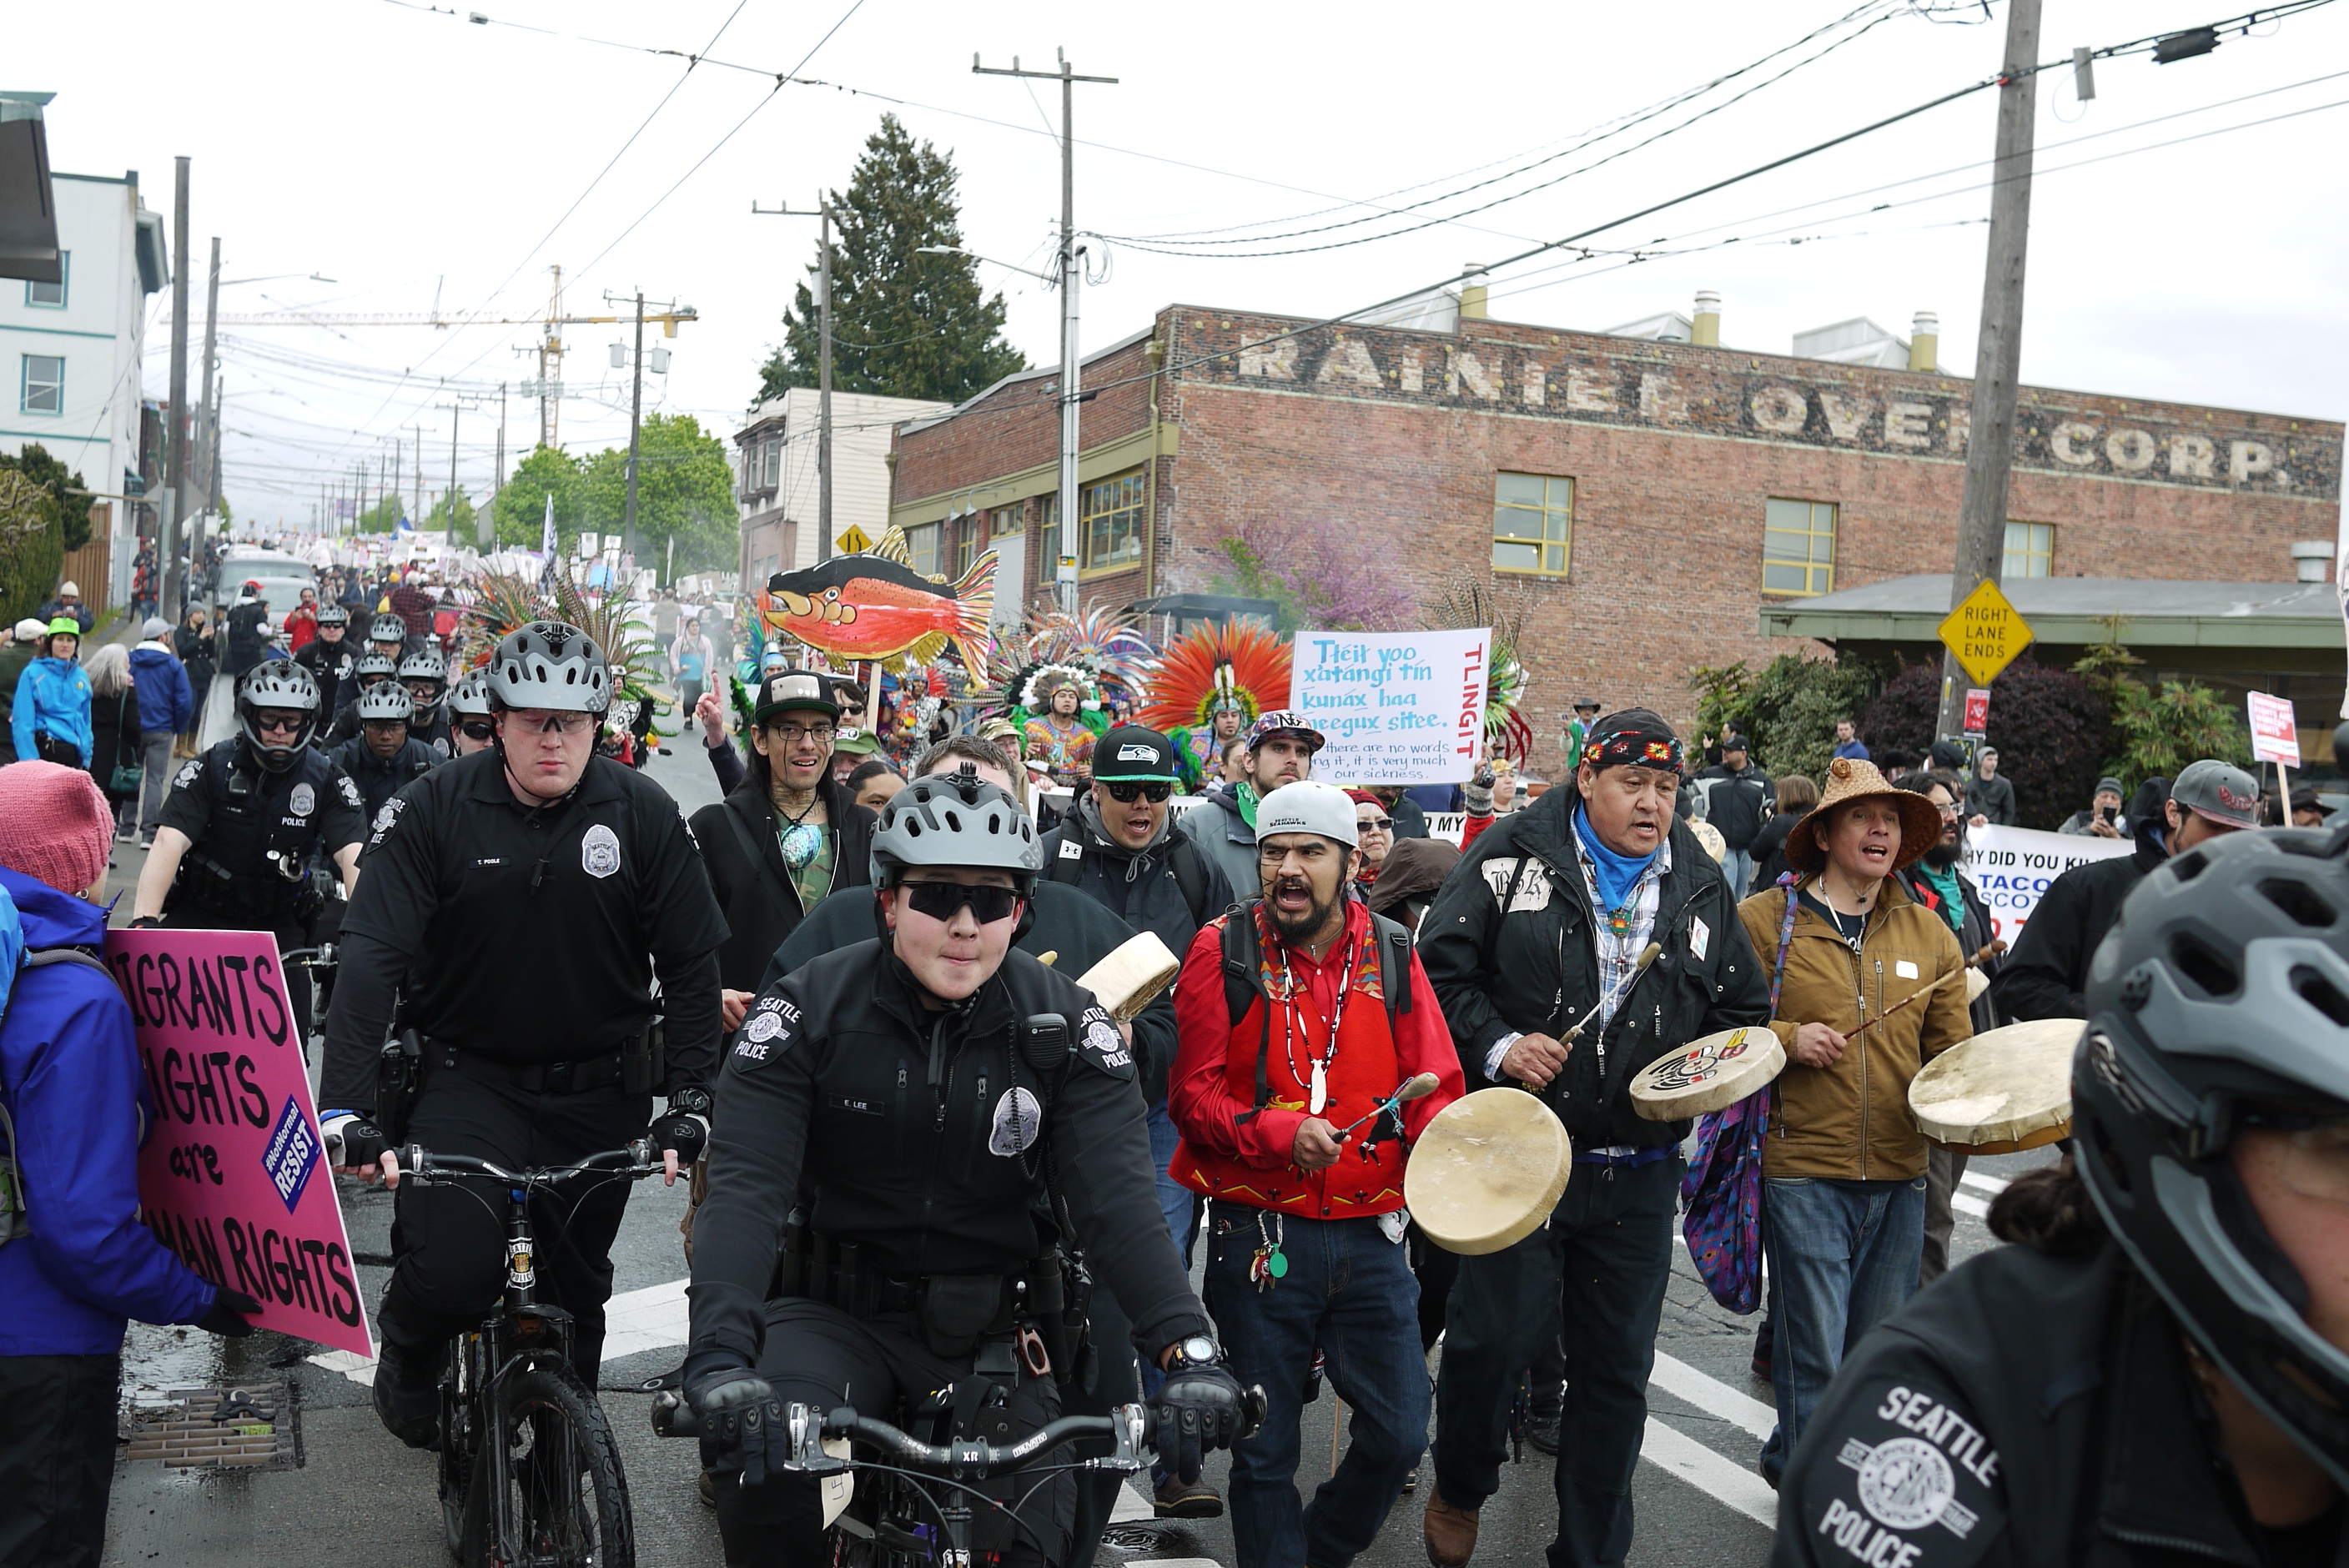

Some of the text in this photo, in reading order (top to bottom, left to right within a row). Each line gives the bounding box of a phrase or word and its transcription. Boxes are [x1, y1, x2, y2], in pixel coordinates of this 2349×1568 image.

[1965, 607, 2009, 621] RIGHT
[1966, 626, 2005, 641] LANE
[1377, 647, 1416, 671] yoo
[1965, 644, 2004, 658] ENDS
[1379, 689, 1416, 707] haa
[1456, 642, 1482, 759] TLINGIT
[1325, 740, 1450, 753] there are no words
[1355, 754, 1364, 766] it
[1369, 755, 1378, 766] is
[1383, 756, 1408, 771] very
[1412, 754, 1446, 766] much
[1335, 767, 1429, 779] our sickness.
[282, 817, 307, 827] POLICE
[1437, 817, 1466, 832] MY
[1989, 851, 2016, 866] DID
[2024, 853, 2059, 870] YOU
[1979, 874, 2052, 892] TACO
[108, 952, 288, 1046] IGRANTS
[757, 997, 802, 1023] SEATTLE
[1080, 1007, 1109, 1028] ATTLE
[735, 1041, 770, 1060] POLICE
[1102, 1049, 1131, 1068] POLICE
[853, 1101, 868, 1110] LEE
[265, 1101, 299, 1173] #NotNormal
[169, 1143, 224, 1185] are
[274, 1118, 313, 1200] RESIST
[223, 1217, 360, 1327] RIGHTS
[1014, 1432, 1047, 1458] TRUVATIV
[1878, 1385, 1999, 1488] SEATTLE
[1818, 1498, 1923, 1568] POLICE
